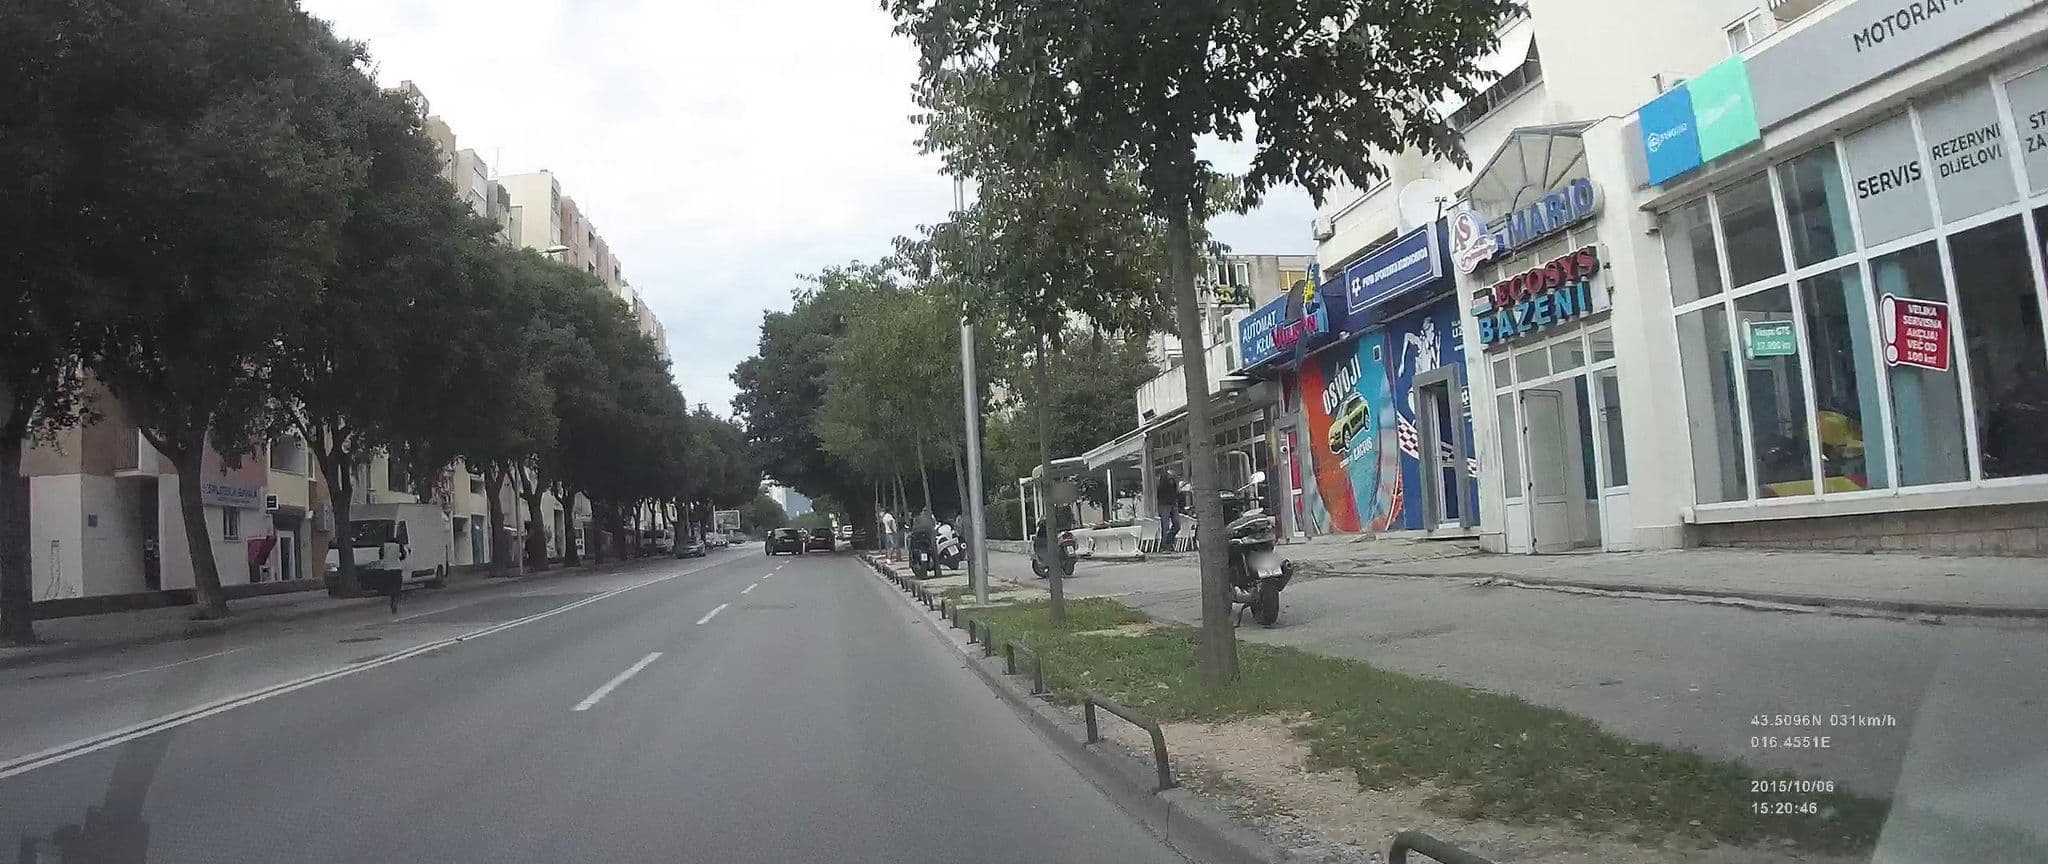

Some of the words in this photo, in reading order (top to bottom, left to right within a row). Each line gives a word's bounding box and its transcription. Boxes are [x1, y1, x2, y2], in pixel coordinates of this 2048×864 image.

[1853, 0, 1964, 52] MOTORA
[1931, 122, 2001, 161] REZERVNI
[1939, 143, 2002, 178] DIJELOVI
[2025, 133, 2047, 153] ZA
[1857, 161, 1922, 199] SERVIS
[1508, 177, 1595, 248] MARIO
[1494, 248, 1598, 307] ECOSYS
[1242, 310, 1277, 343] AUTOMAT
[1478, 280, 1591, 345] BAZENI
[1908, 304, 1938, 316] VELIKA
[1256, 328, 1276, 355] KLU
[1322, 353, 1362, 415] OSVOJI
